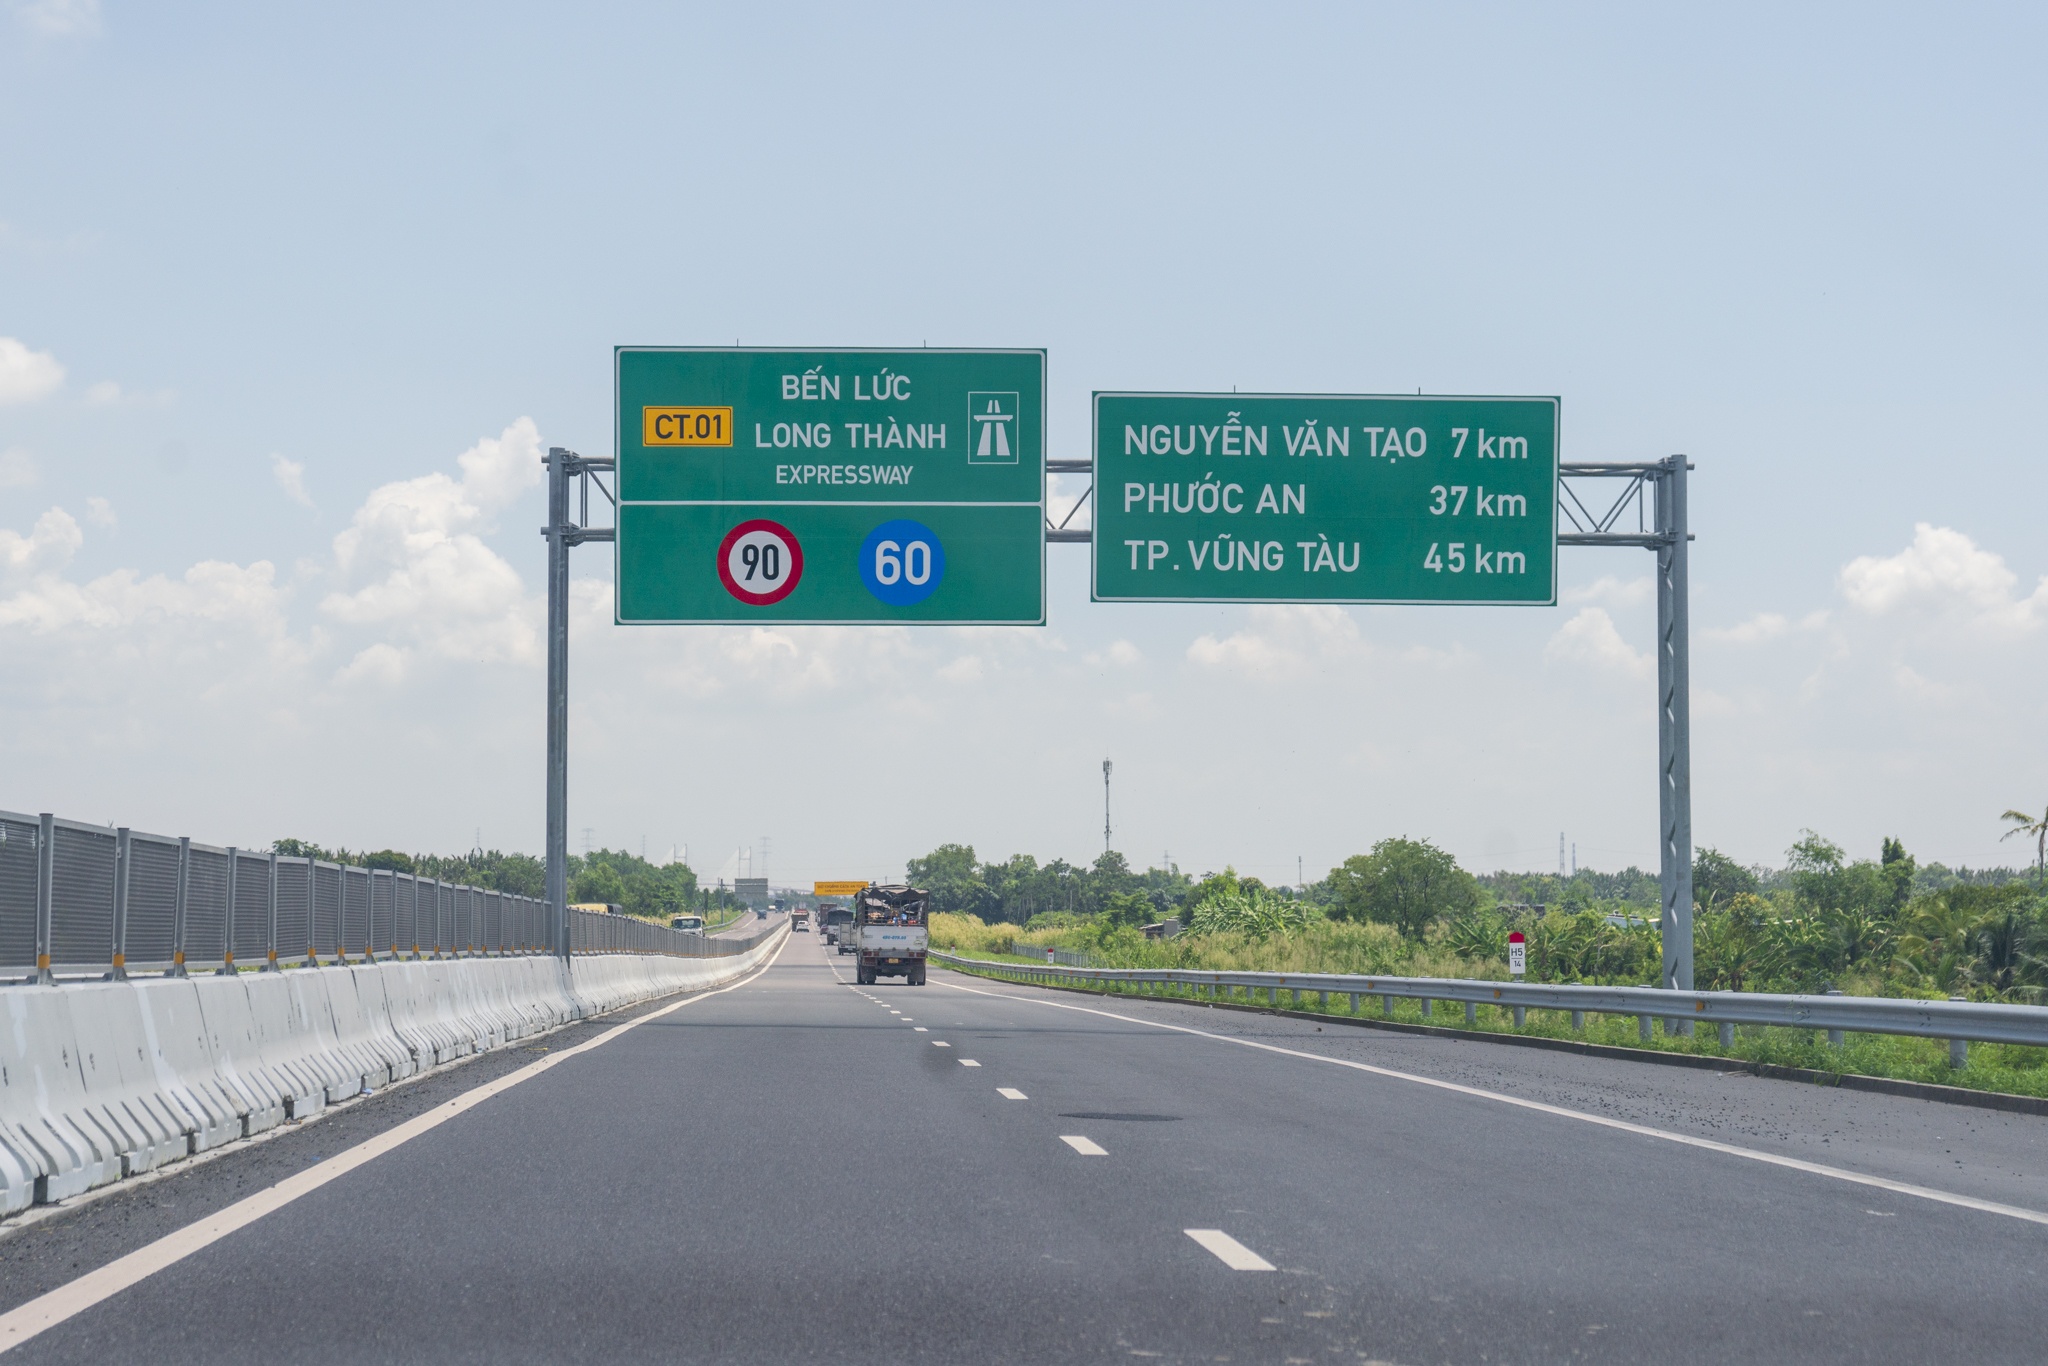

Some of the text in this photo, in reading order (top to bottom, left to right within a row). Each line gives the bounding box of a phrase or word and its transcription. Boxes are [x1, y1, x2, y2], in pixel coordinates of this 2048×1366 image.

[782, 366, 910, 400] BẾN LỨC
[655, 413, 722, 440] CT.01
[756, 416, 945, 448] LONG THÀNH
[1125, 411, 1527, 463] NGUYỄN VĂN TẠO 7 km
[776, 465, 913, 484] EXPRESSWAY
[1125, 472, 1526, 516] PHƯỚC AN 37 km
[742, 544, 779, 580] 90
[876, 541, 930, 585] 60
[1188, 534, 1283, 571] VŨNG
[1297, 534, 1359, 572] TÀU
[1424, 543, 1465, 573] 45
[1476, 544, 1525, 573] km
[1511, 948, 1523, 956] H5
